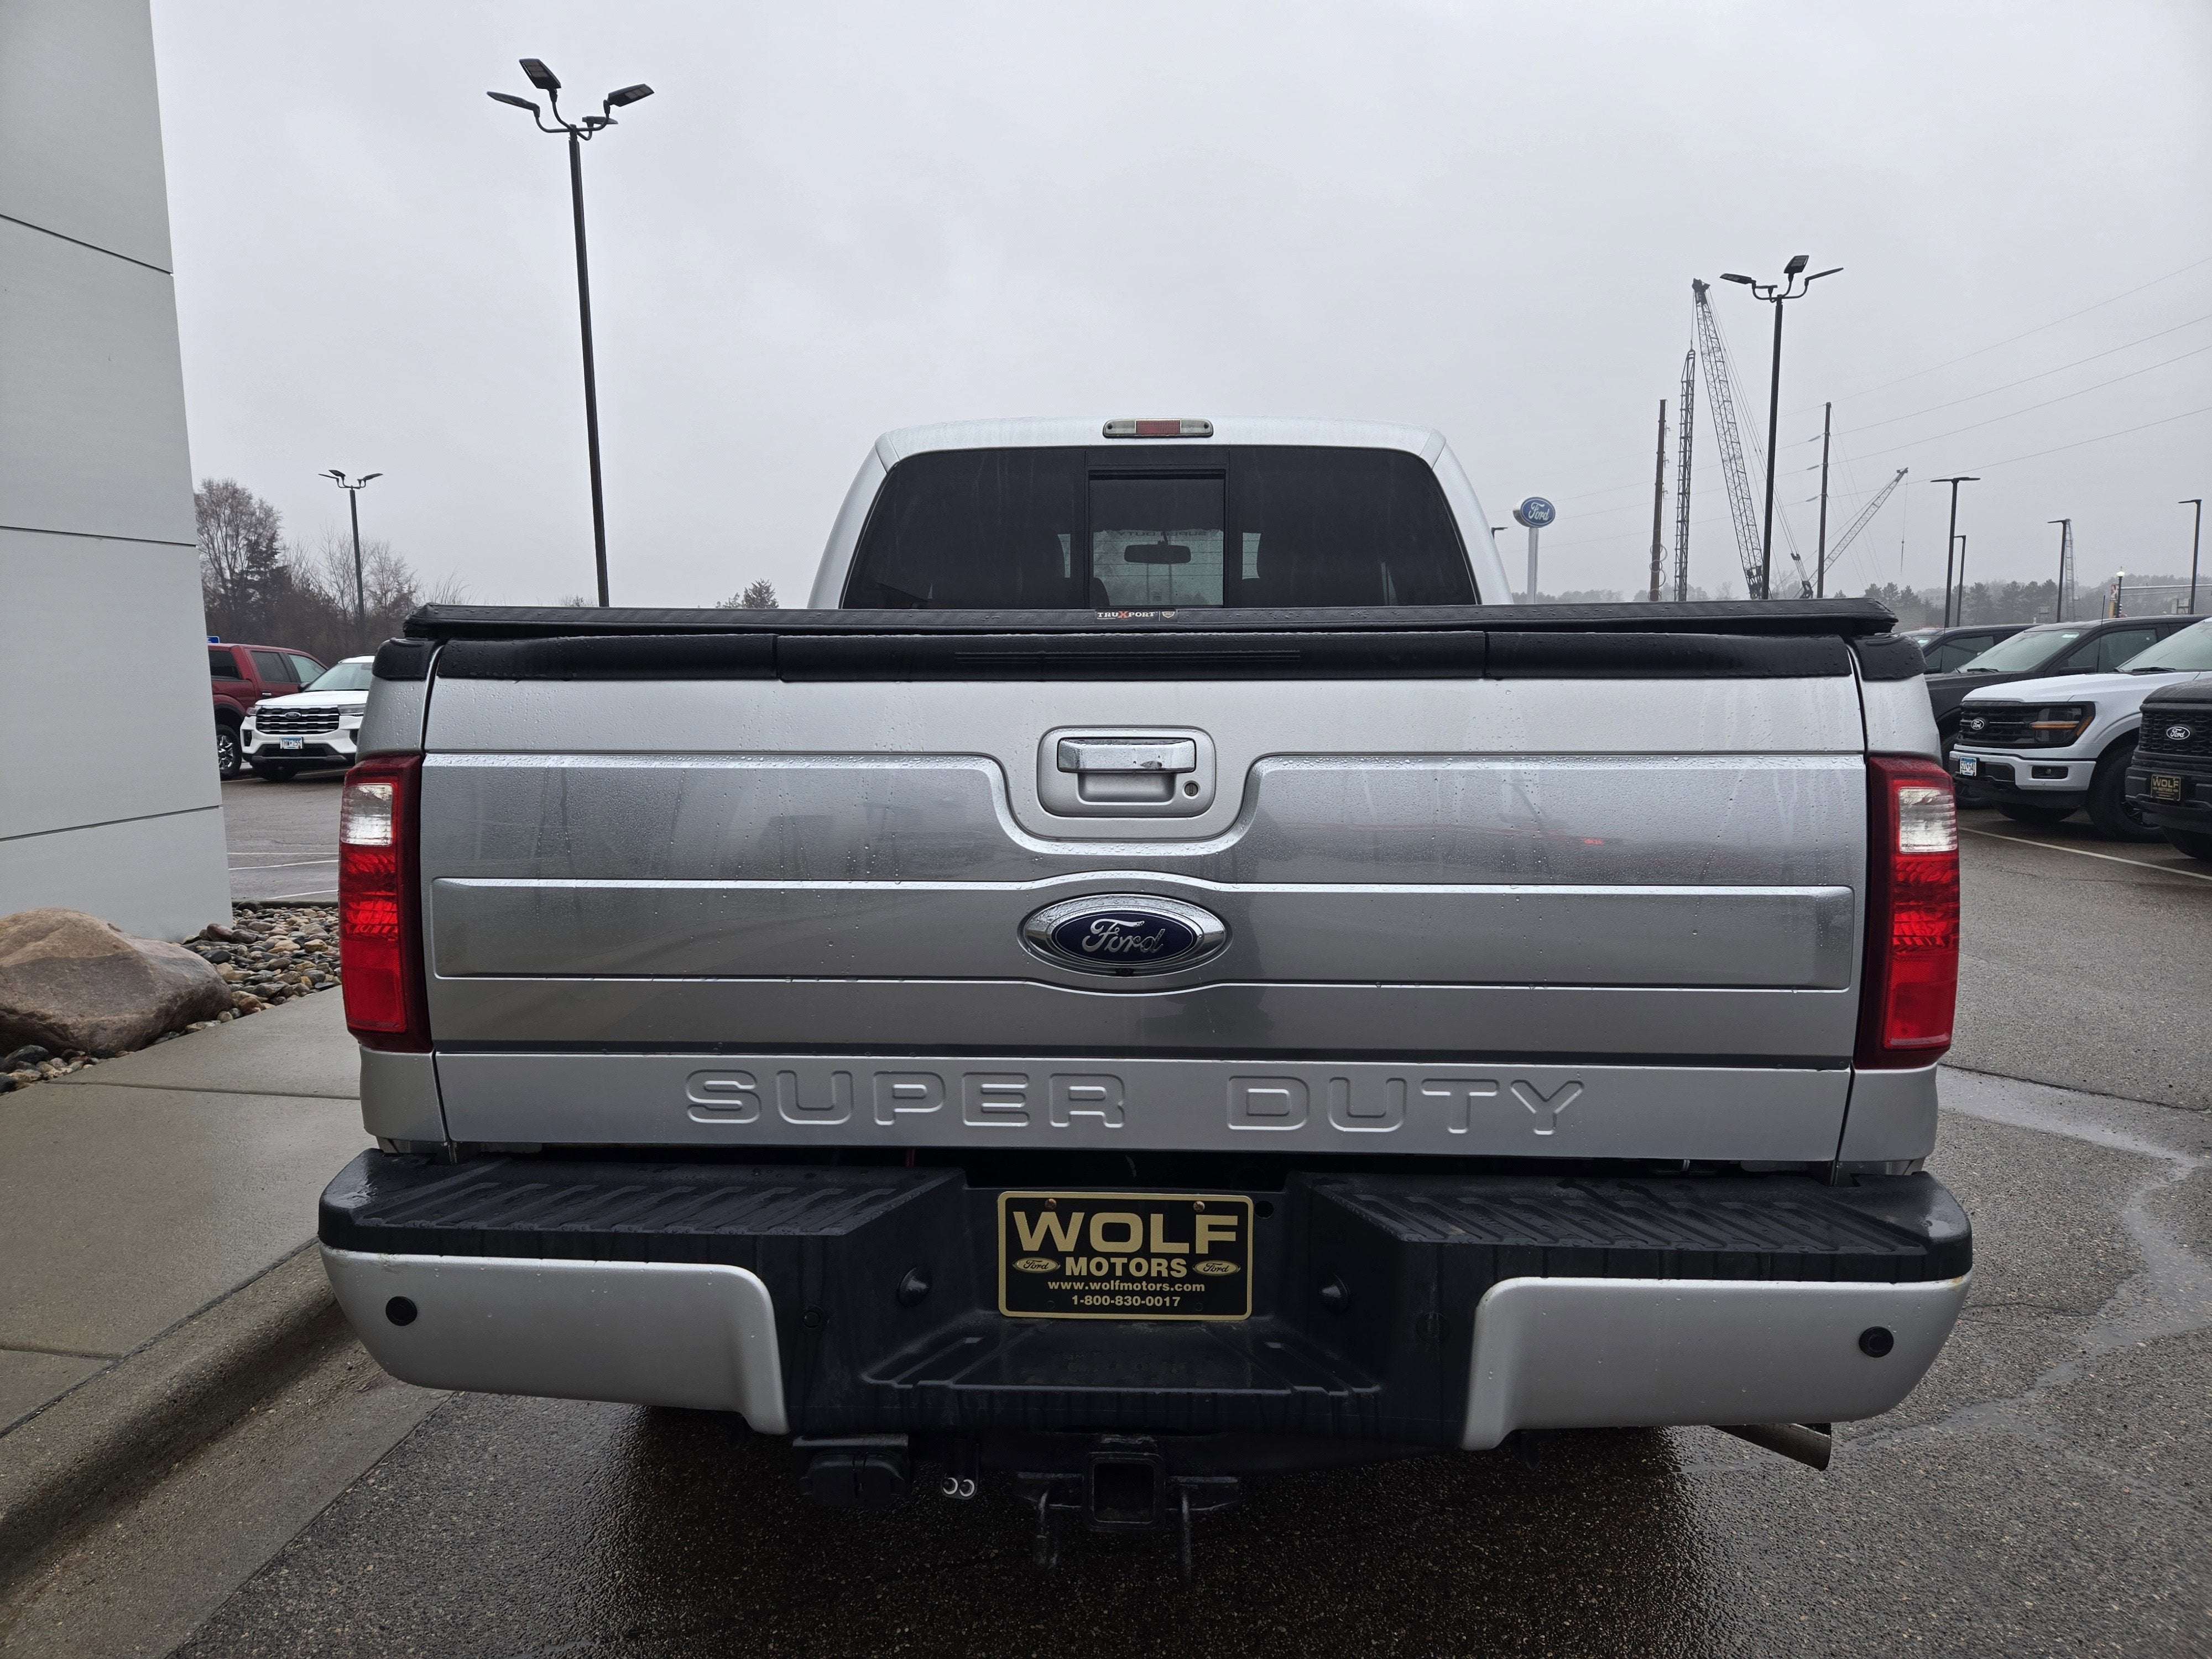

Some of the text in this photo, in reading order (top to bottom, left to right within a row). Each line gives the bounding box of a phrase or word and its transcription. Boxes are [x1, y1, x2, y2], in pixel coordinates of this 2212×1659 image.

[1528, 502, 1550, 521] Ford
[2170, 728, 2186, 738] Ford
[2153, 778, 2179, 788] WOLF
[1082, 918, 1166, 953] Ford
[685, 1069, 1585, 1135] SUPER DUTY
[1013, 1211, 1238, 1254] WOLF
[1023, 1260, 1050, 1270] Ford
[1065, 1257, 1187, 1278] MOTORS
[1203, 1262, 1230, 1272] Ford
[1047, 1280, 1206, 1292] www.wolfmotors.com
[1072, 1295, 1181, 1307] 1-800-830-0017
